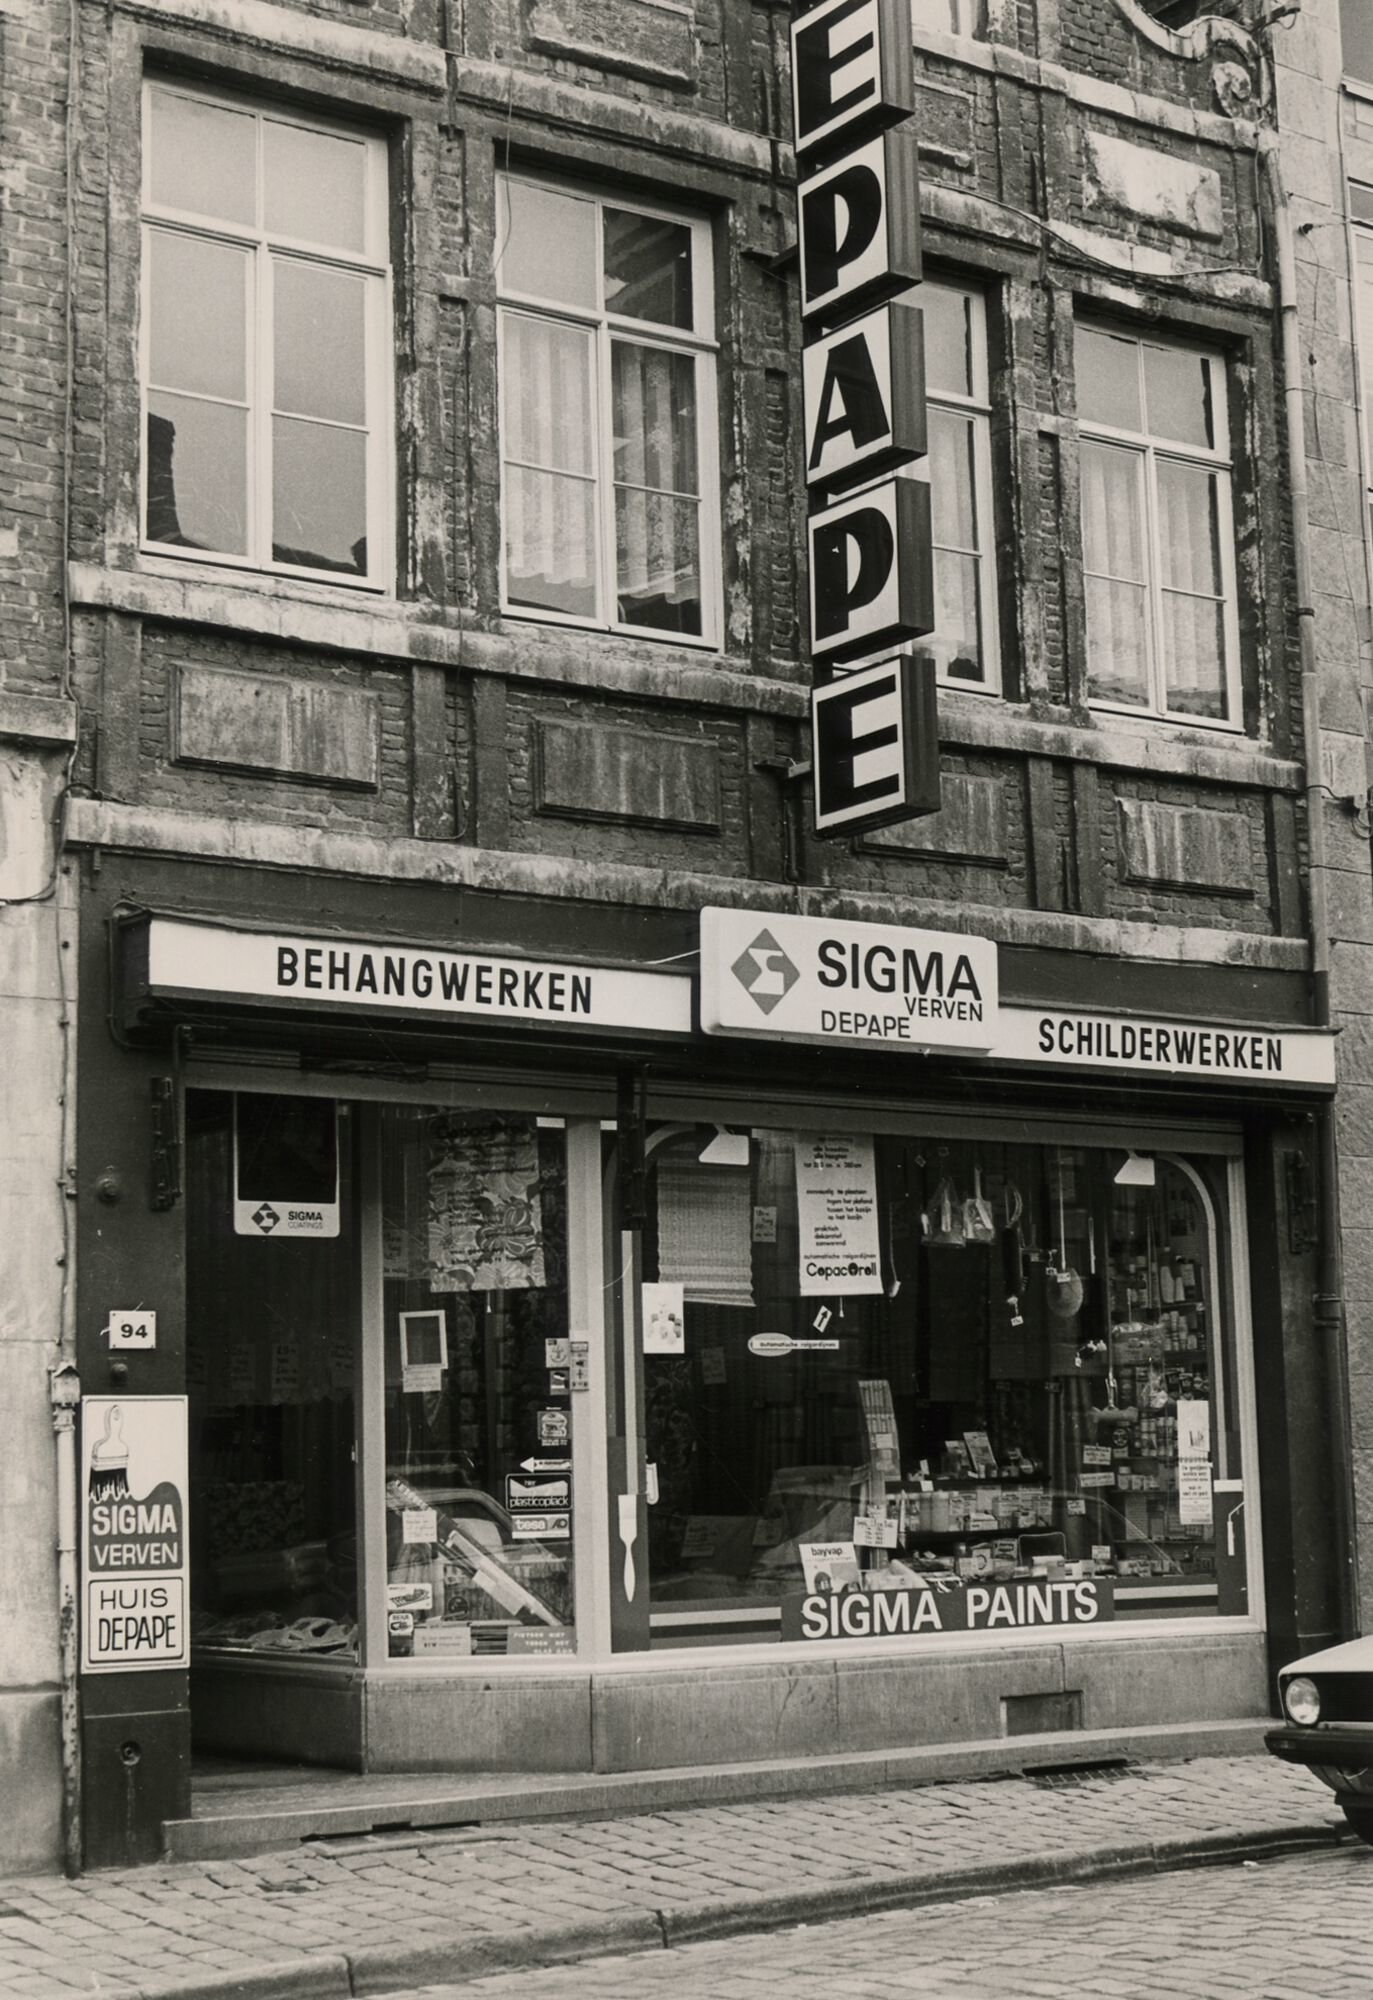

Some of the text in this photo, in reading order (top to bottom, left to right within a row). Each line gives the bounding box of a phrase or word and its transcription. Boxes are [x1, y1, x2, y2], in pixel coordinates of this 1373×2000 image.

[277, 946, 592, 1014] BEHANGWERKEN
[817, 939, 982, 1001] SIGMA
[821, 1009, 911, 1039] DEPAPE
[903, 995, 983, 1022] VERVEN
[1038, 1018, 1282, 1072] SCHILDERWERKEN
[288, 1211, 323, 1221] SIGMA
[120, 1323, 148, 1339] 94
[92, 1503, 178, 1536] SIGMA
[93, 1541, 178, 1567] VERVEN
[100, 1587, 169, 1611] HUIS
[801, 1581, 1098, 1639] SIGMA PAINTS
[98, 1614, 176, 1652] DEPAPE
